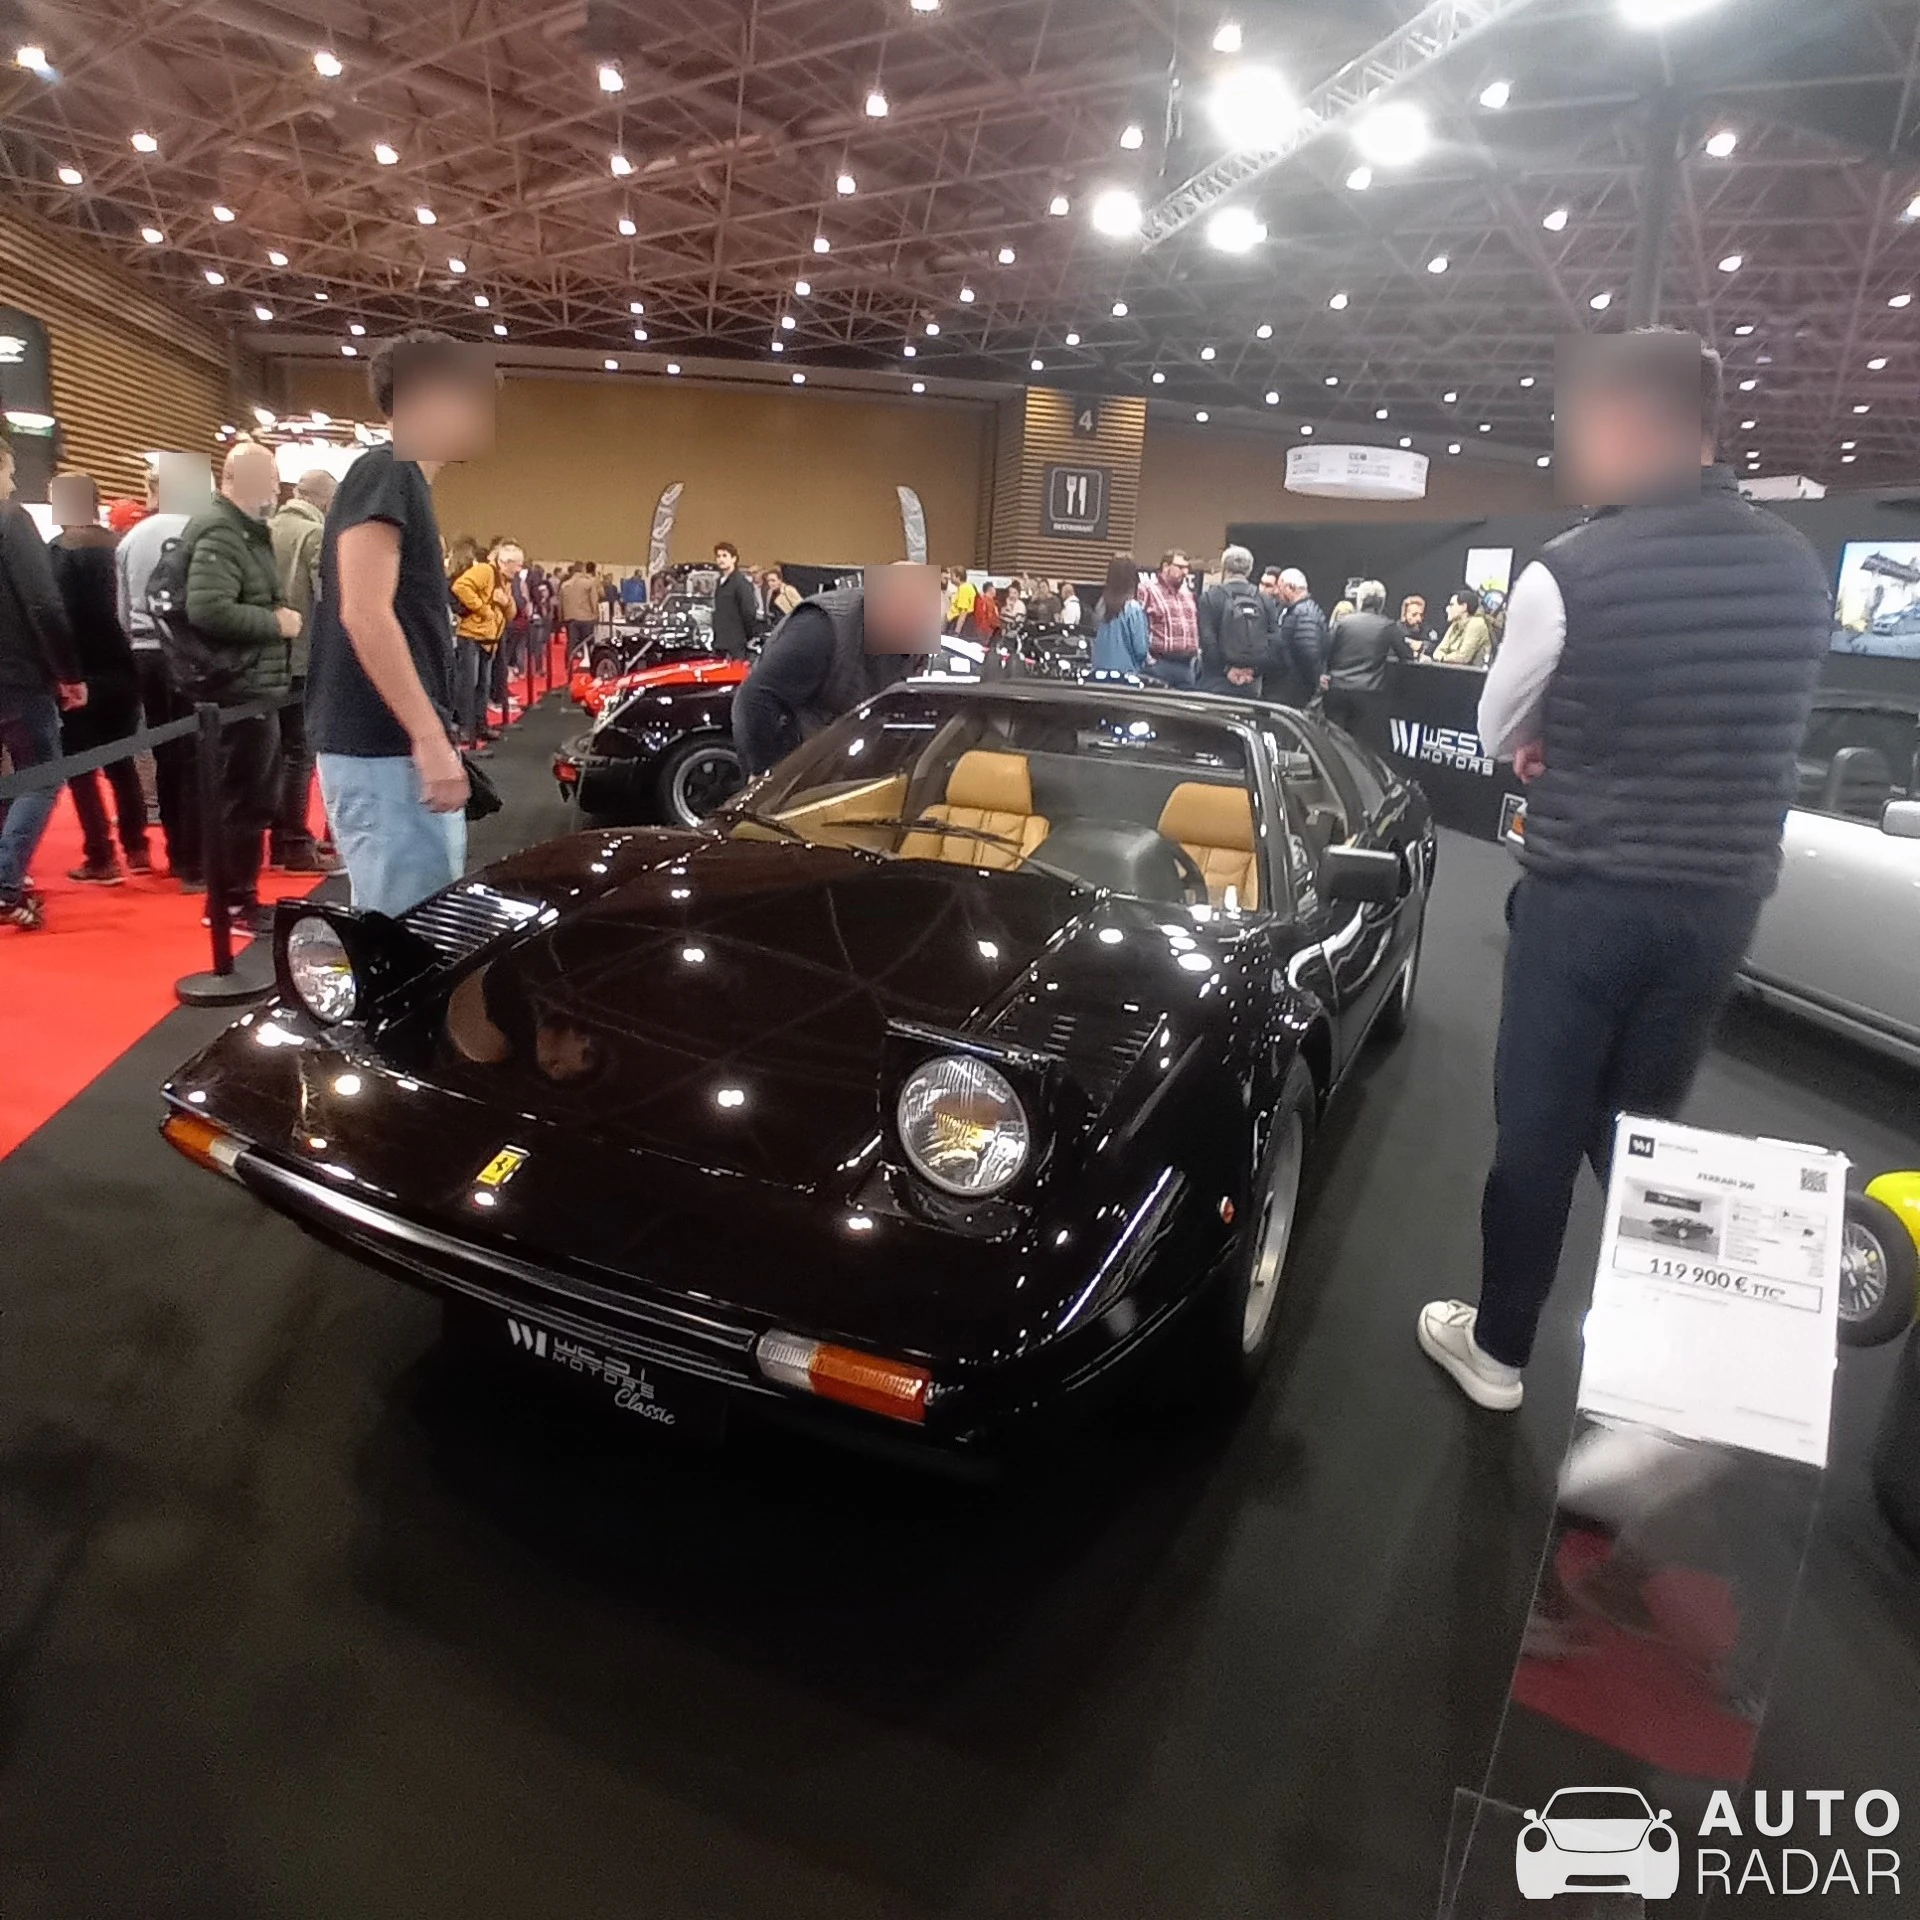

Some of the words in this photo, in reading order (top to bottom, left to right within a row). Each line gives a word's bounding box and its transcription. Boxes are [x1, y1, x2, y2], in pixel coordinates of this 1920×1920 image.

[1079, 409, 1093, 432] 4
[1422, 725, 1480, 757] WES
[1420, 748, 1494, 777] MOTORS
[1650, 1257, 1687, 1280] 119
[1692, 1266, 1730, 1288] 900
[1735, 1276, 1748, 1293] €
[552, 1351, 655, 1399] MOTORS
[614, 1387, 676, 1425] Classic
